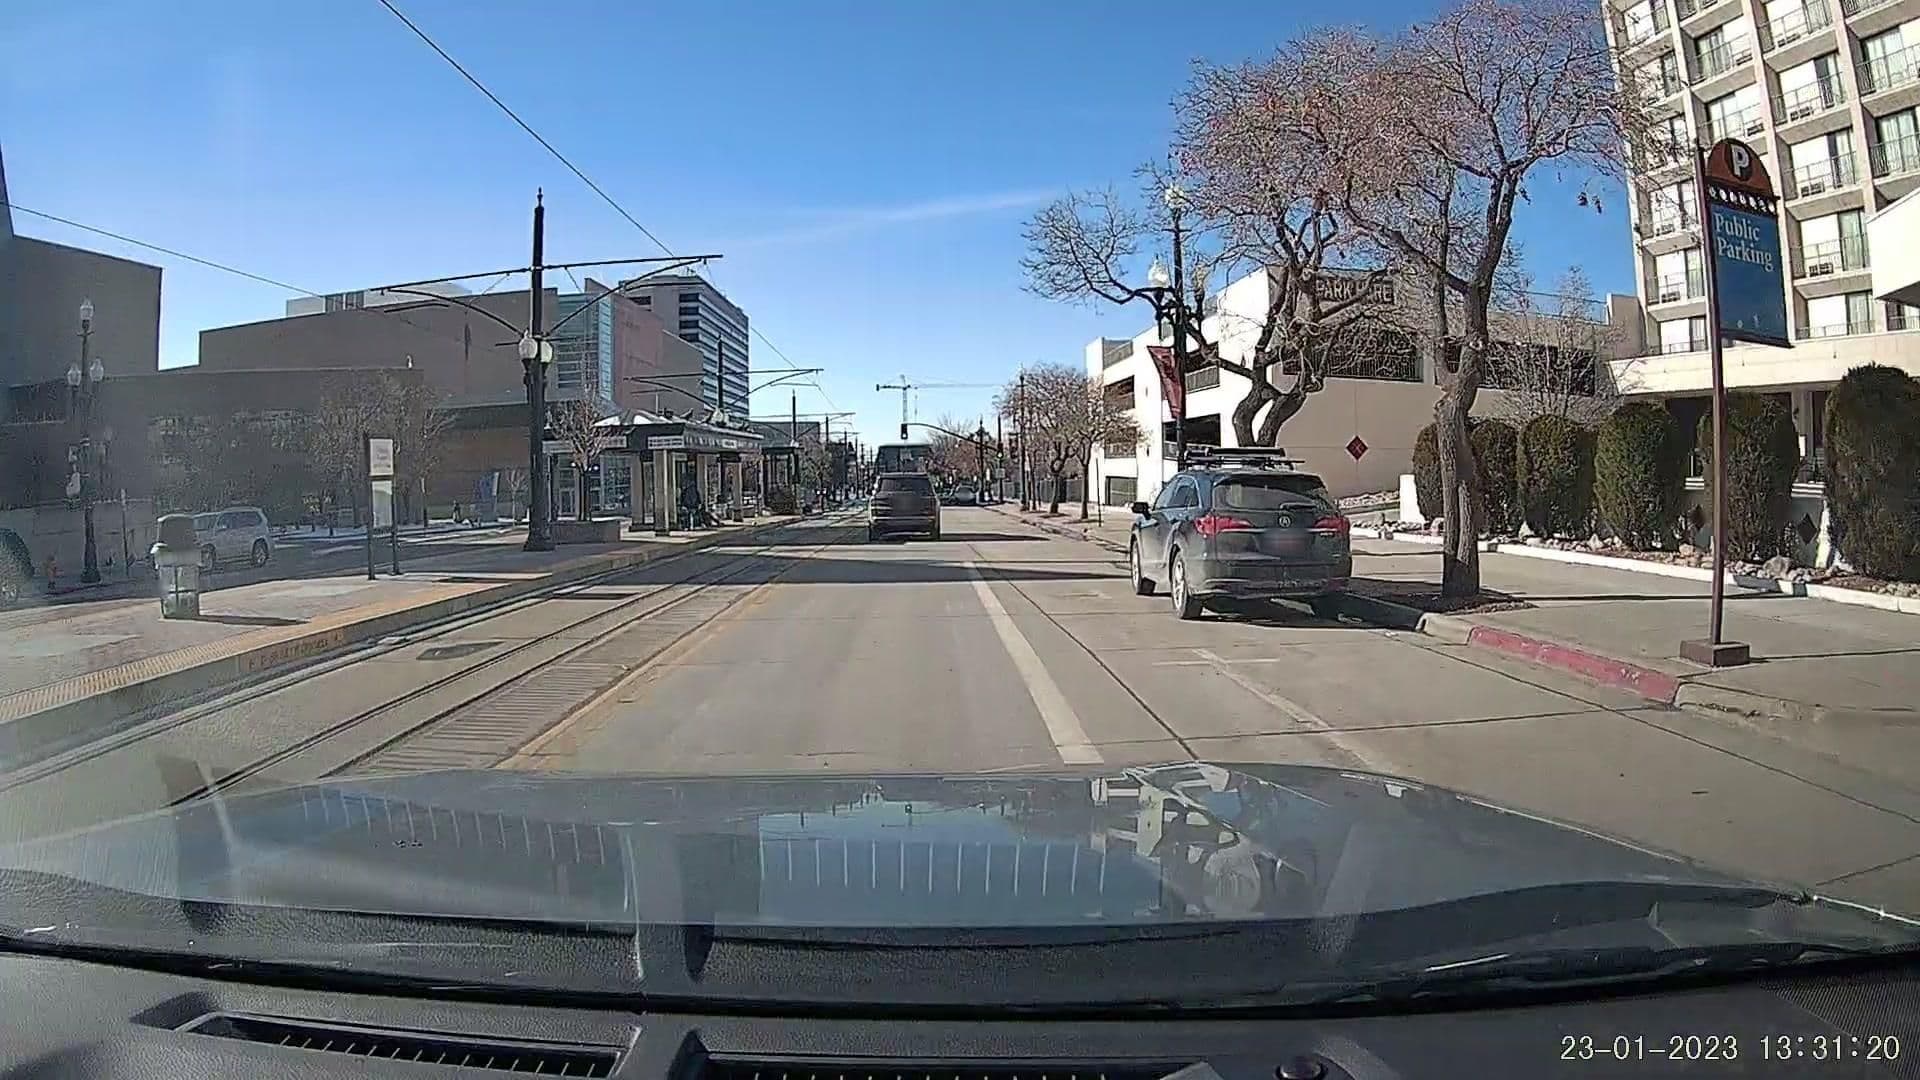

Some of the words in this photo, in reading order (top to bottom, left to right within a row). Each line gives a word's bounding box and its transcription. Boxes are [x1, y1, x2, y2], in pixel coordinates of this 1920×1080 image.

[1730, 143, 1750, 177] P
[1713, 212, 1760, 241] Public
[1717, 236, 1774, 272] Parking
[1315, 279, 1353, 300] PARK
